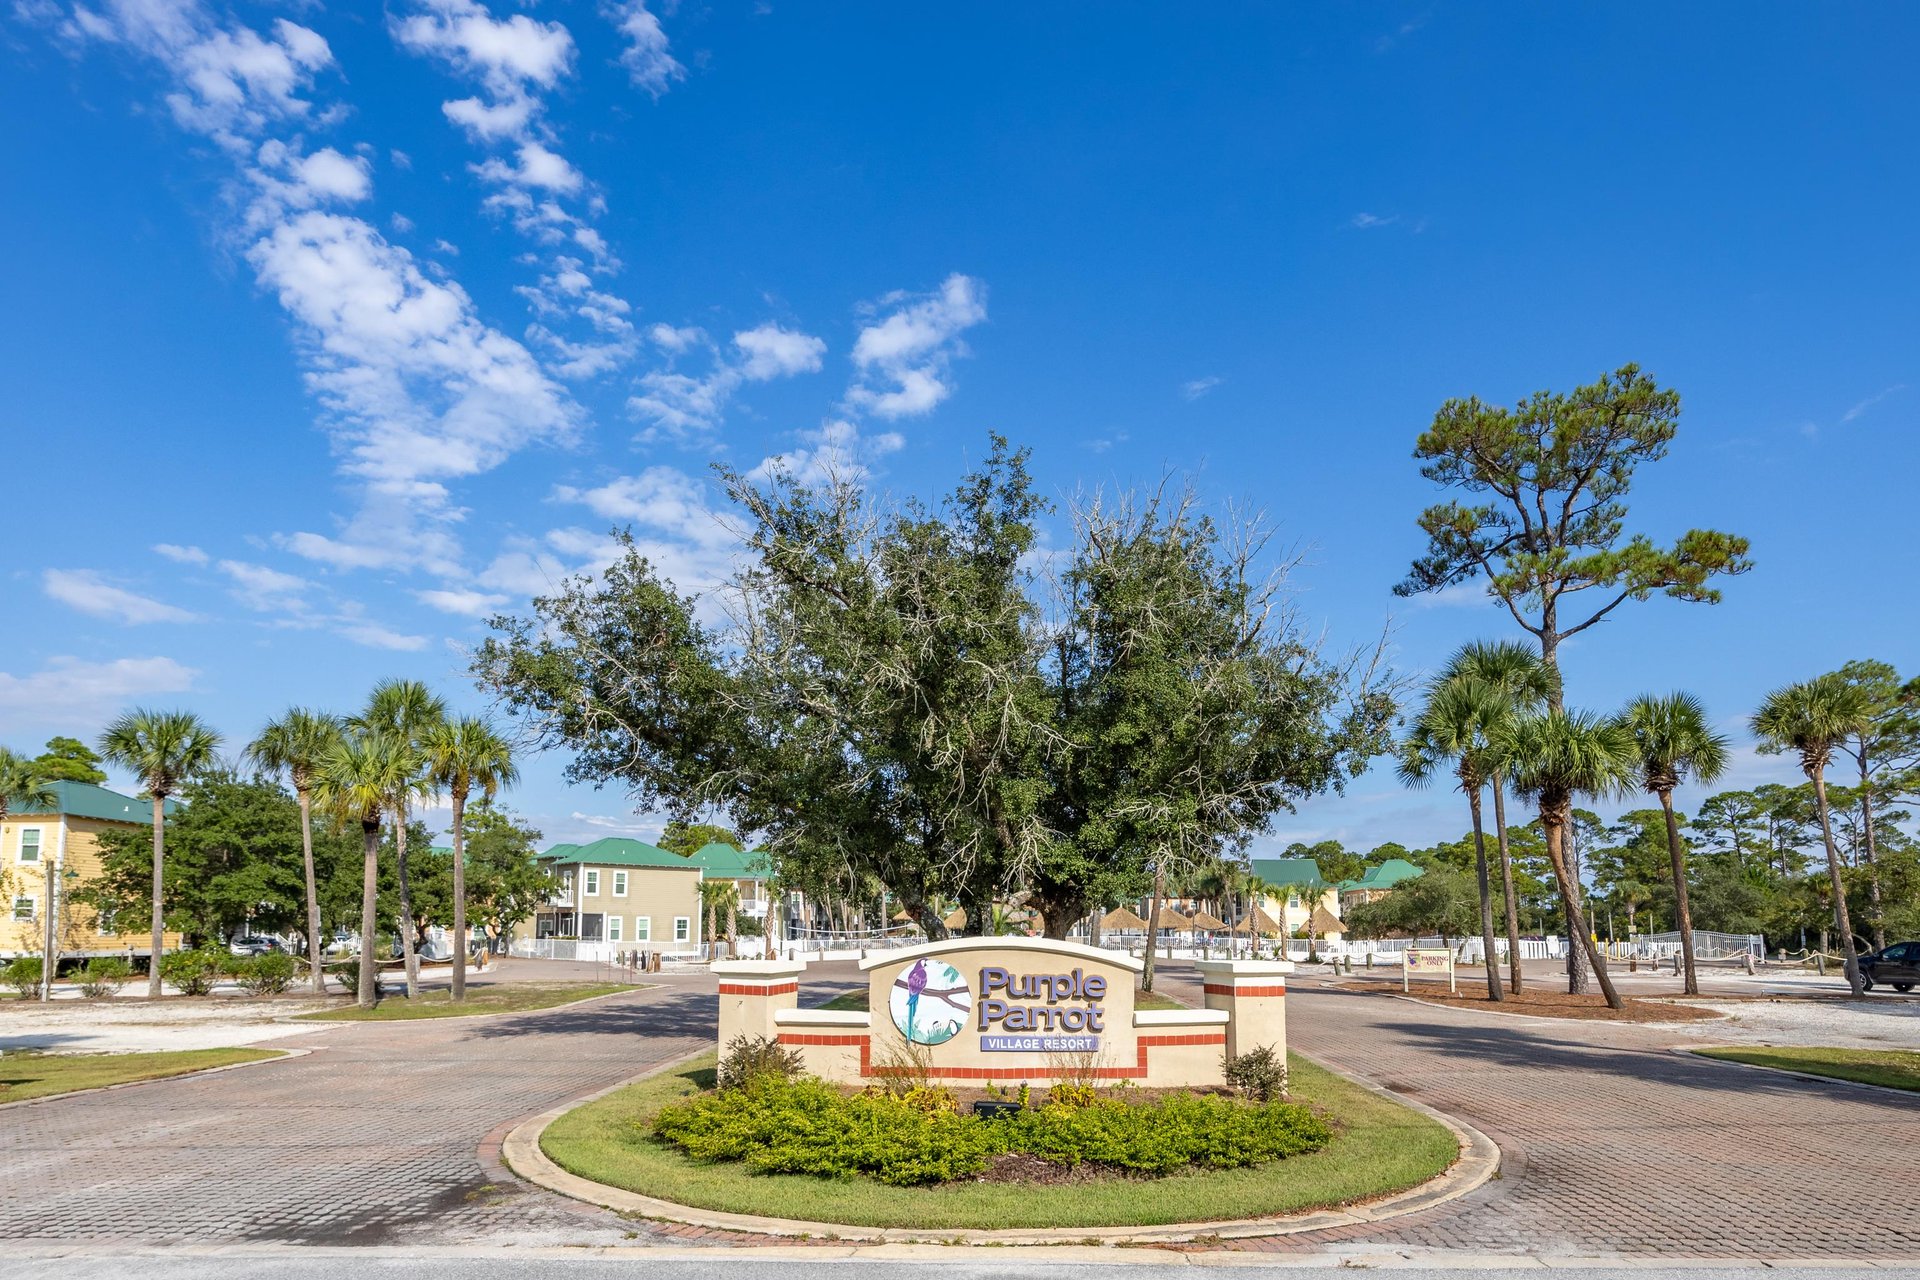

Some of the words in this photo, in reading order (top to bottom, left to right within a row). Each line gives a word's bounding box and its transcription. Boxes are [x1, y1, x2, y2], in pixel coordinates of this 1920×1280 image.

[979, 967, 1107, 1004] Purple
[977, 1000, 1105, 1032] Parrot
[988, 1038, 1040, 1049] VILLAGE
[1043, 1038, 1092, 1049] RESORT
